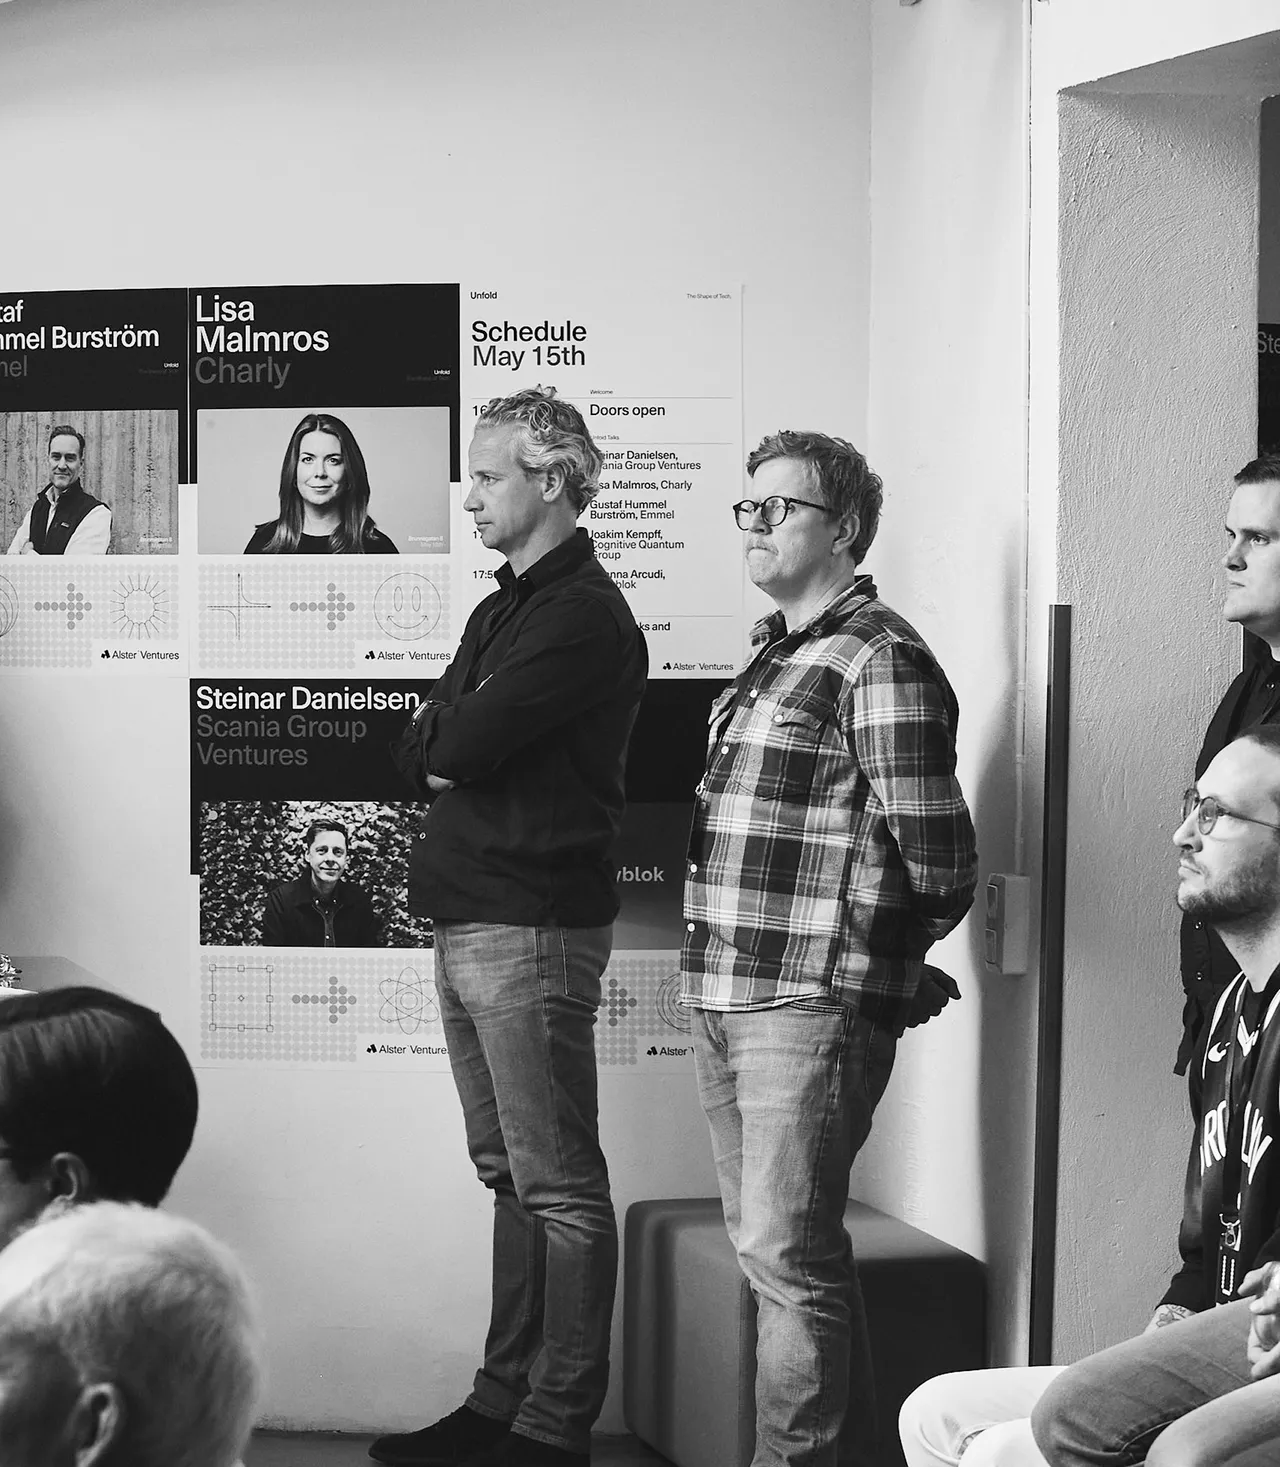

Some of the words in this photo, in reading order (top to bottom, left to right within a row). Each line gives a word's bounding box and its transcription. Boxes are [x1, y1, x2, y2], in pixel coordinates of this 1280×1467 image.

[470, 291, 498, 300] Unfold
[195, 294, 255, 323] Lisa
[51, 324, 160, 349] Burström
[471, 320, 587, 342] Schedule
[196, 324, 330, 353] Malmros
[472, 345, 525, 371] May
[532, 345, 586, 367] 15th
[195, 356, 291, 390] Charly
[589, 403, 630, 416] Doors
[632, 405, 666, 418] open
[604, 450, 625, 460] inar
[626, 450, 679, 461] Danielsen,
[601, 460, 623, 470] ania
[625, 460, 656, 471] Group
[657, 460, 702, 470] Ventures
[598, 481, 610, 490] sa
[612, 480, 659, 490] Malmros,
[660, 480, 693, 491] Charly
[590, 499, 623, 509] Gustaf
[624, 499, 667, 509] Hummel
[590, 509, 638, 520] Burström,
[640, 510, 675, 519] Emmel
[591, 529, 624, 539] Joakim
[626, 529, 663, 540] Kempff,
[638, 540, 684, 550] Quantum
[472, 570, 494, 579] 17:5
[630, 569, 666, 580] Arcudi,
[651, 621, 671, 631] and
[112, 650, 137, 660] Alster
[139, 650, 180, 660] Ventures
[377, 651, 405, 660] Alster
[407, 651, 452, 661] Ventures
[672, 662, 696, 671] Alster
[698, 662, 734, 671] Ventures
[196, 685, 286, 710] Steinar
[291, 686, 420, 710] Danielsen
[196, 714, 281, 738] Scania
[287, 714, 367, 743] Group
[196, 742, 308, 766] Ventures
[378, 1044, 407, 1054] Alster
[409, 1044, 449, 1054] Venture
[659, 1046, 688, 1056] Alster
